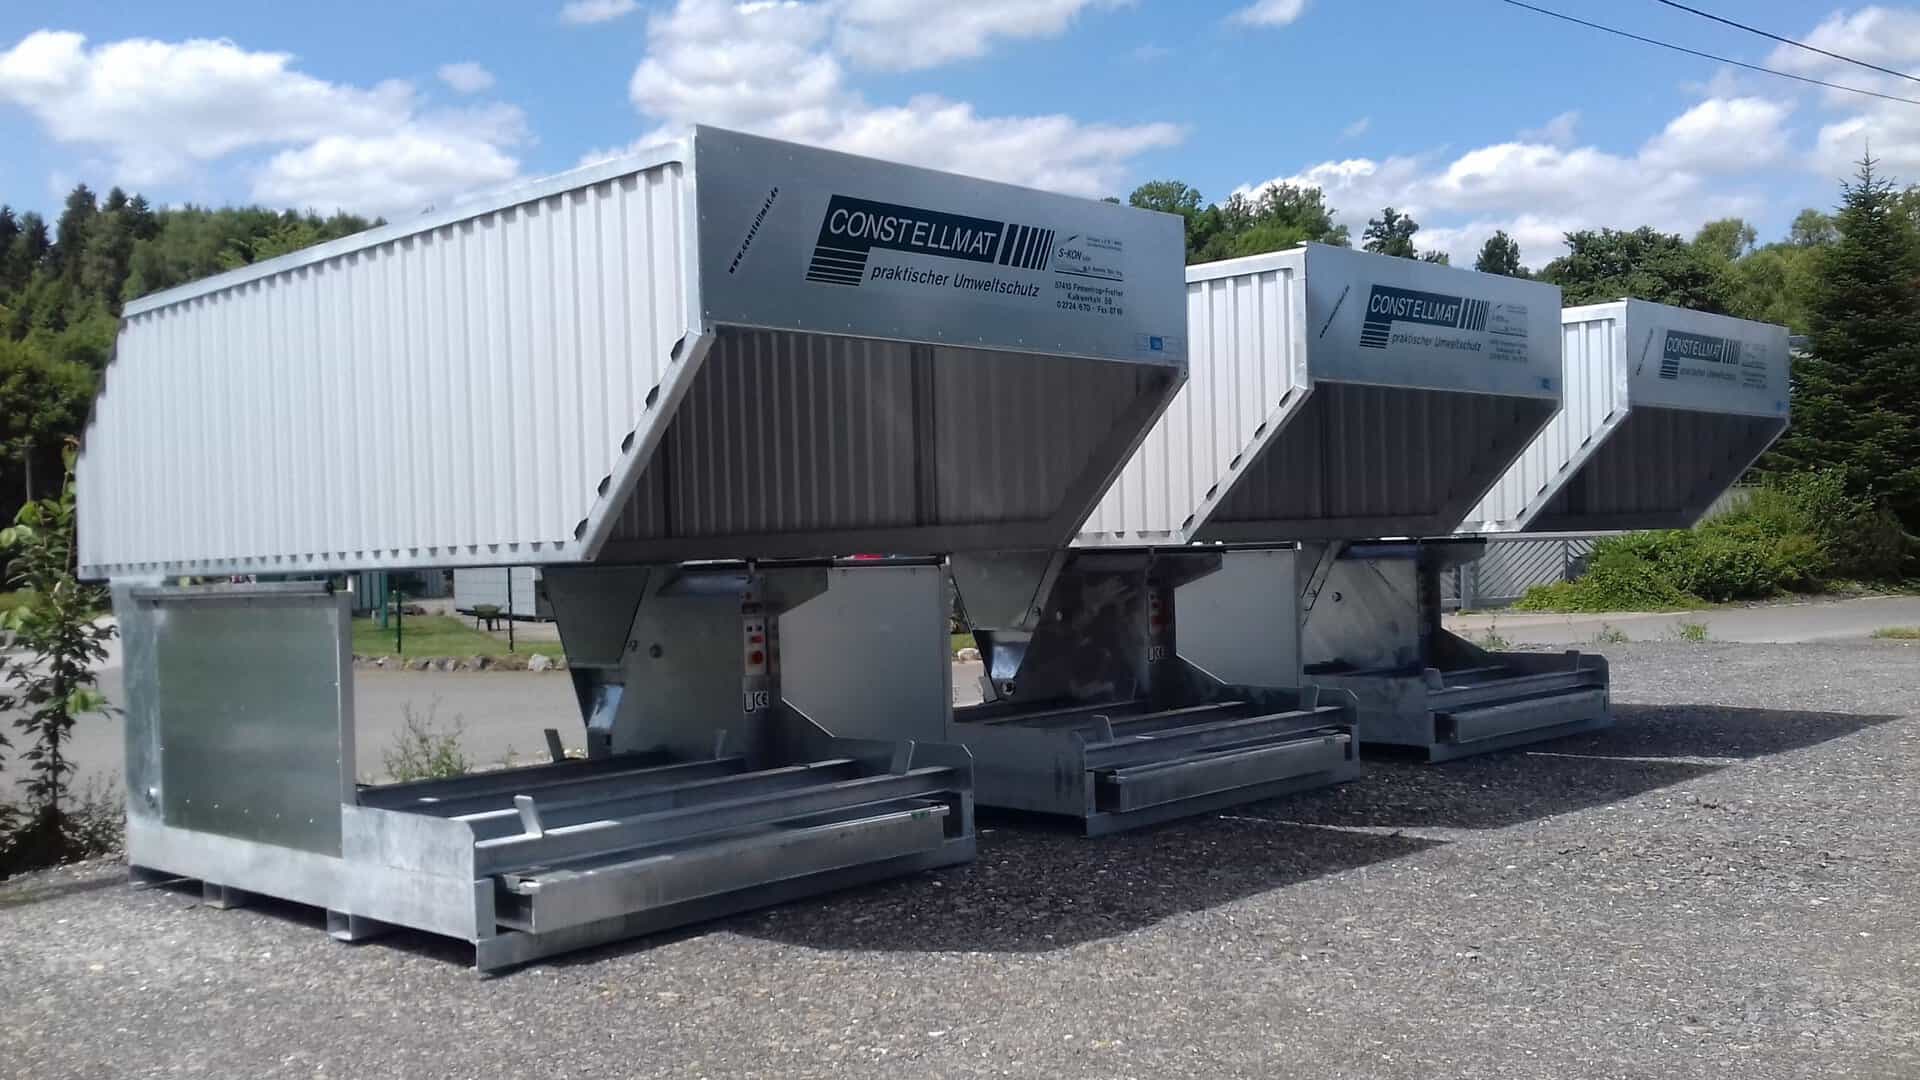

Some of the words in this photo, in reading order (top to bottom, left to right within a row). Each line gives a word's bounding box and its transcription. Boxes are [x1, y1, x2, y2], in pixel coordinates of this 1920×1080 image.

[830, 208, 997, 256] CONSTELLMAT
[871, 264, 949, 287] praktischer
[953, 273, 1040, 298] Umweltschutz
[1370, 294, 1459, 322] CONSTELLMAT
[1666, 336, 1722, 359] CONSTELLMAT
